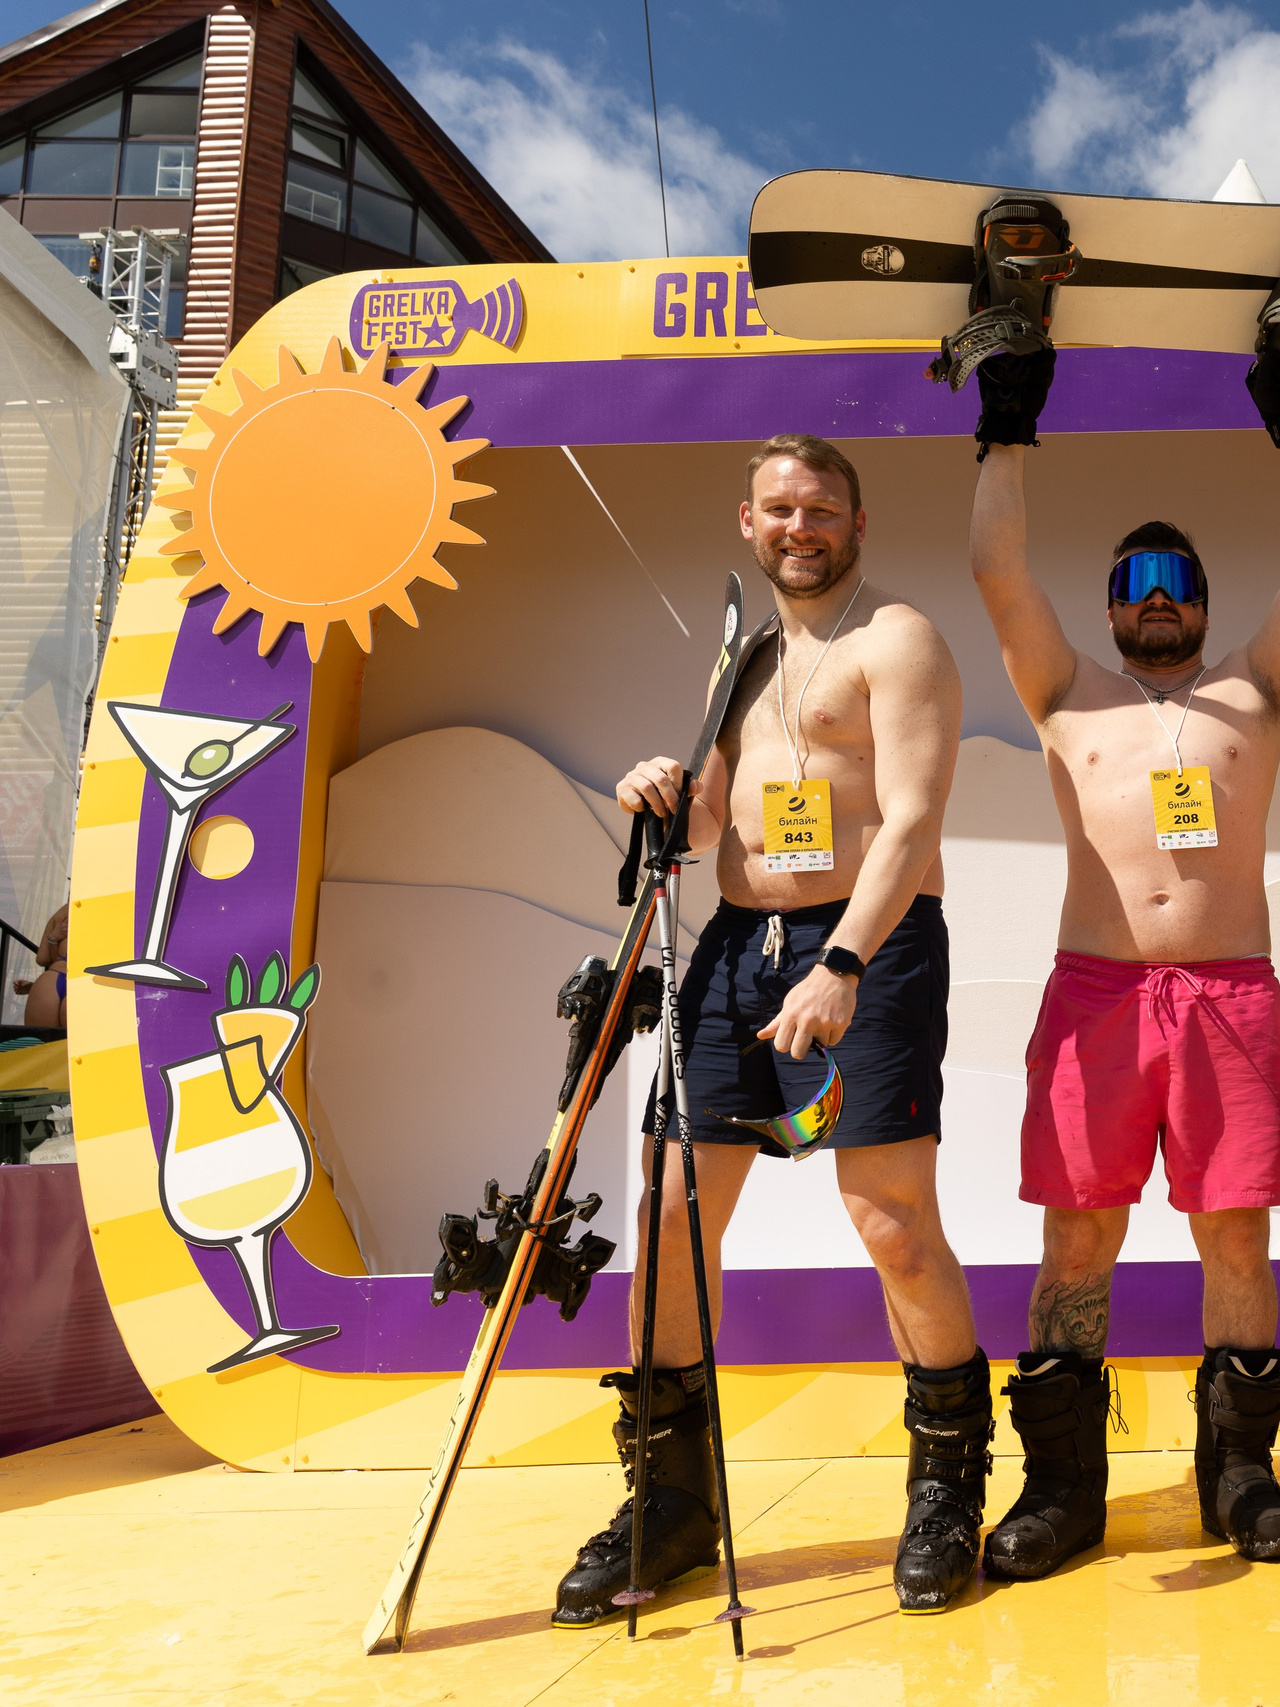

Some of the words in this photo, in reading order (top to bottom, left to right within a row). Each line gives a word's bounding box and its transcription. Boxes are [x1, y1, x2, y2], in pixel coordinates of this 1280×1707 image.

[368, 290, 450, 318] GRELKA
[366, 320, 423, 347] FEST
[1167, 799, 1202, 810] билайн
[778, 816, 818, 826] билайн
[1174, 813, 1199, 825] 208
[785, 832, 813, 844] 843
[626, 1428, 673, 1445] FISHER
[914, 1424, 960, 1437] FISCHER
